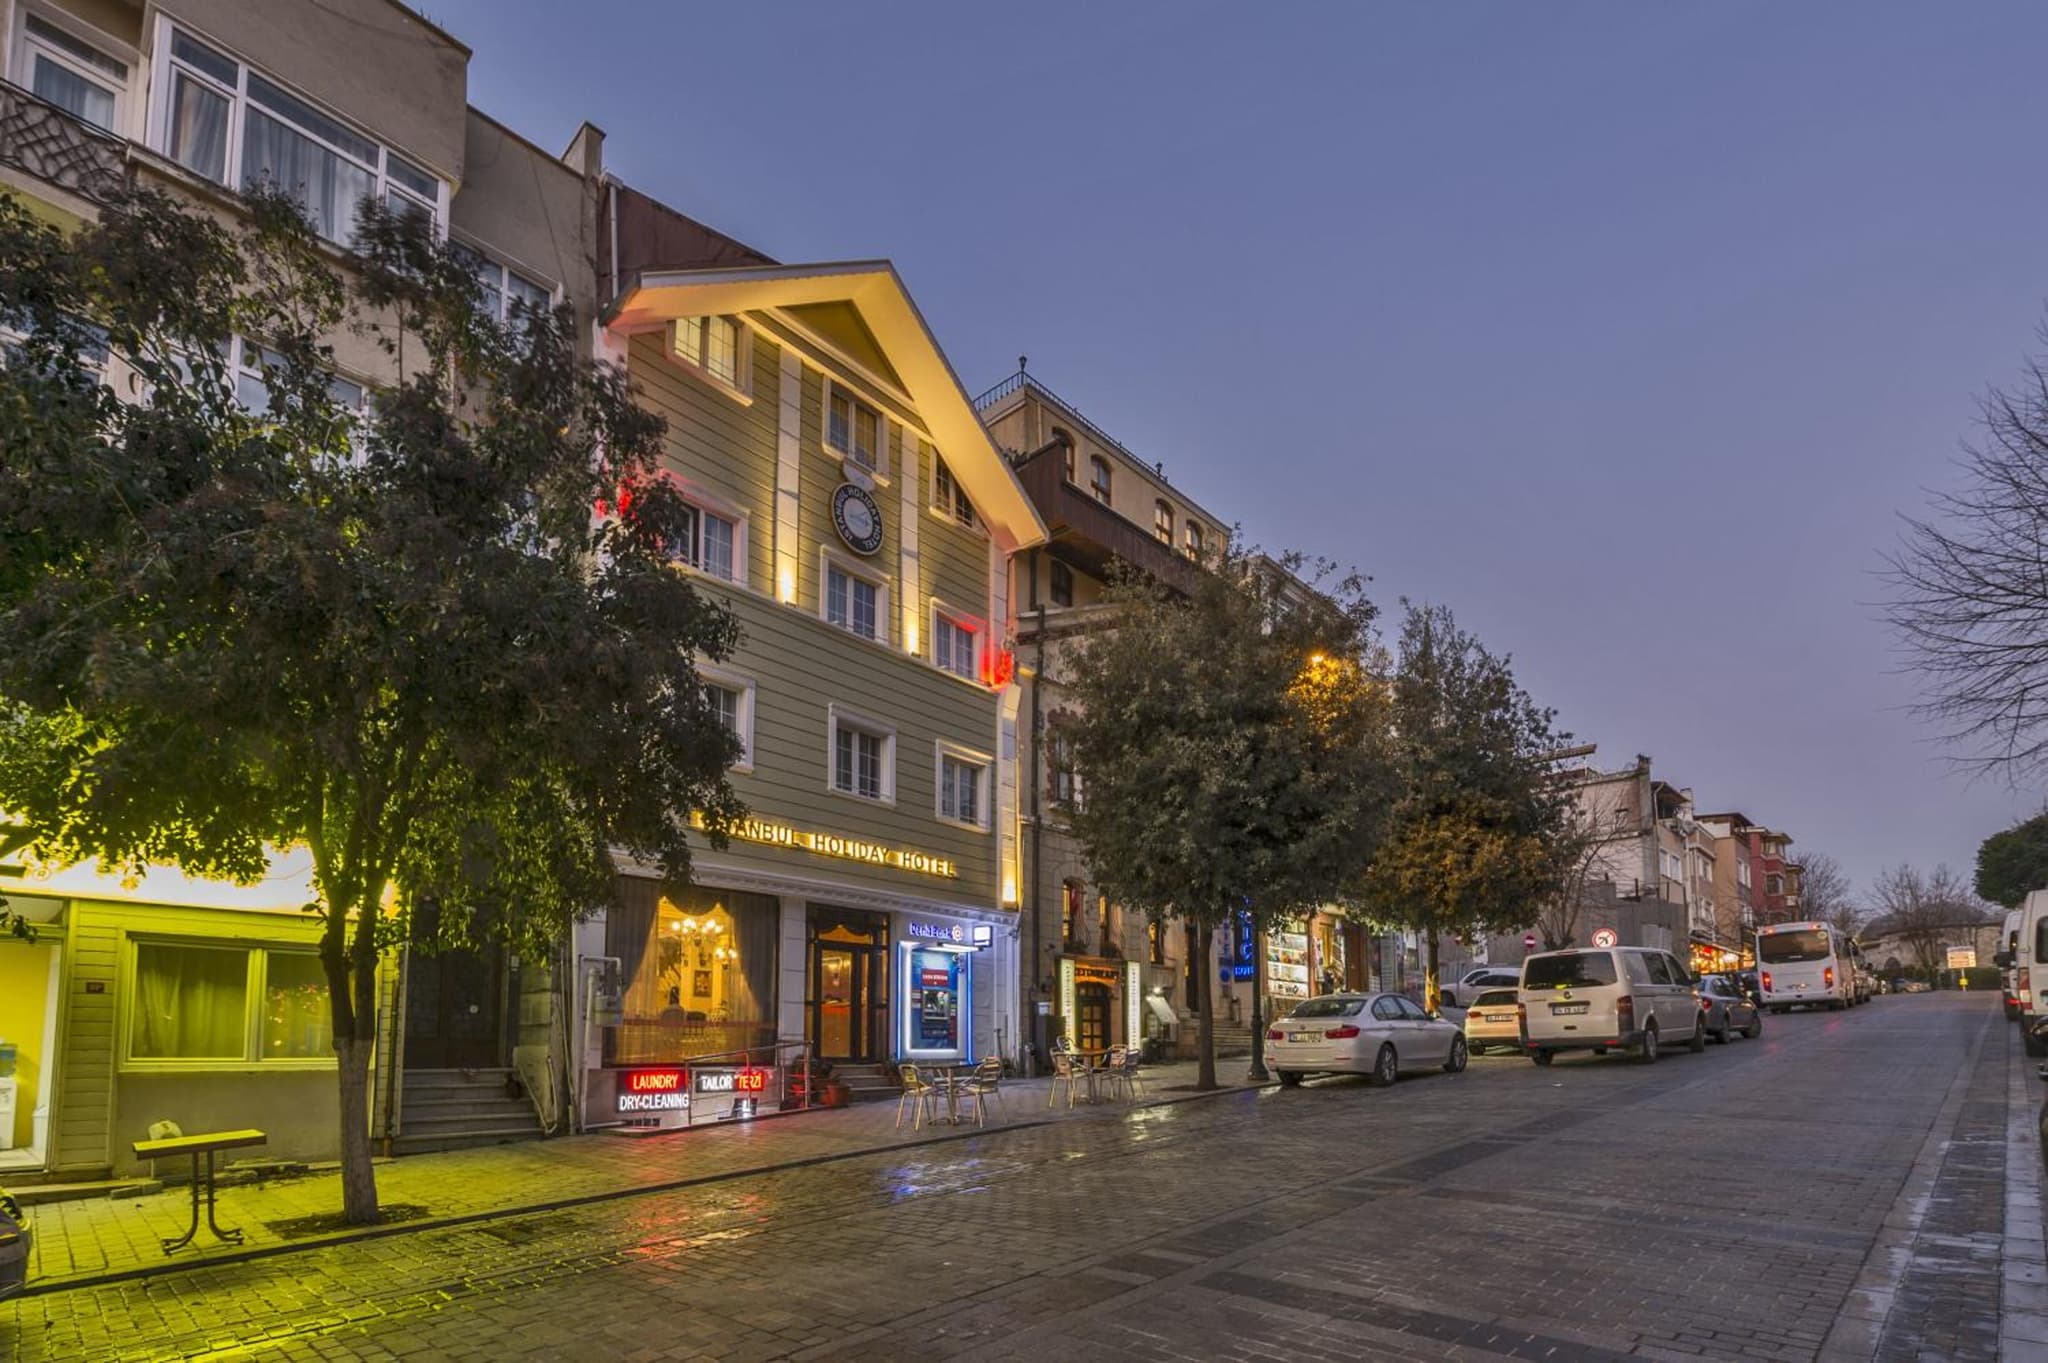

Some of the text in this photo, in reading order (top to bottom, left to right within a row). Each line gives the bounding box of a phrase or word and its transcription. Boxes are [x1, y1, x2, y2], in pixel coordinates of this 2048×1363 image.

[811, 832, 890, 864] HOLIDAY
[901, 851, 958, 878] HOTEL
[632, 1073, 679, 1090] LAUNDRY
[700, 1074, 733, 1090] TAILOR
[618, 1092, 690, 1112] DRY-CLEANING
